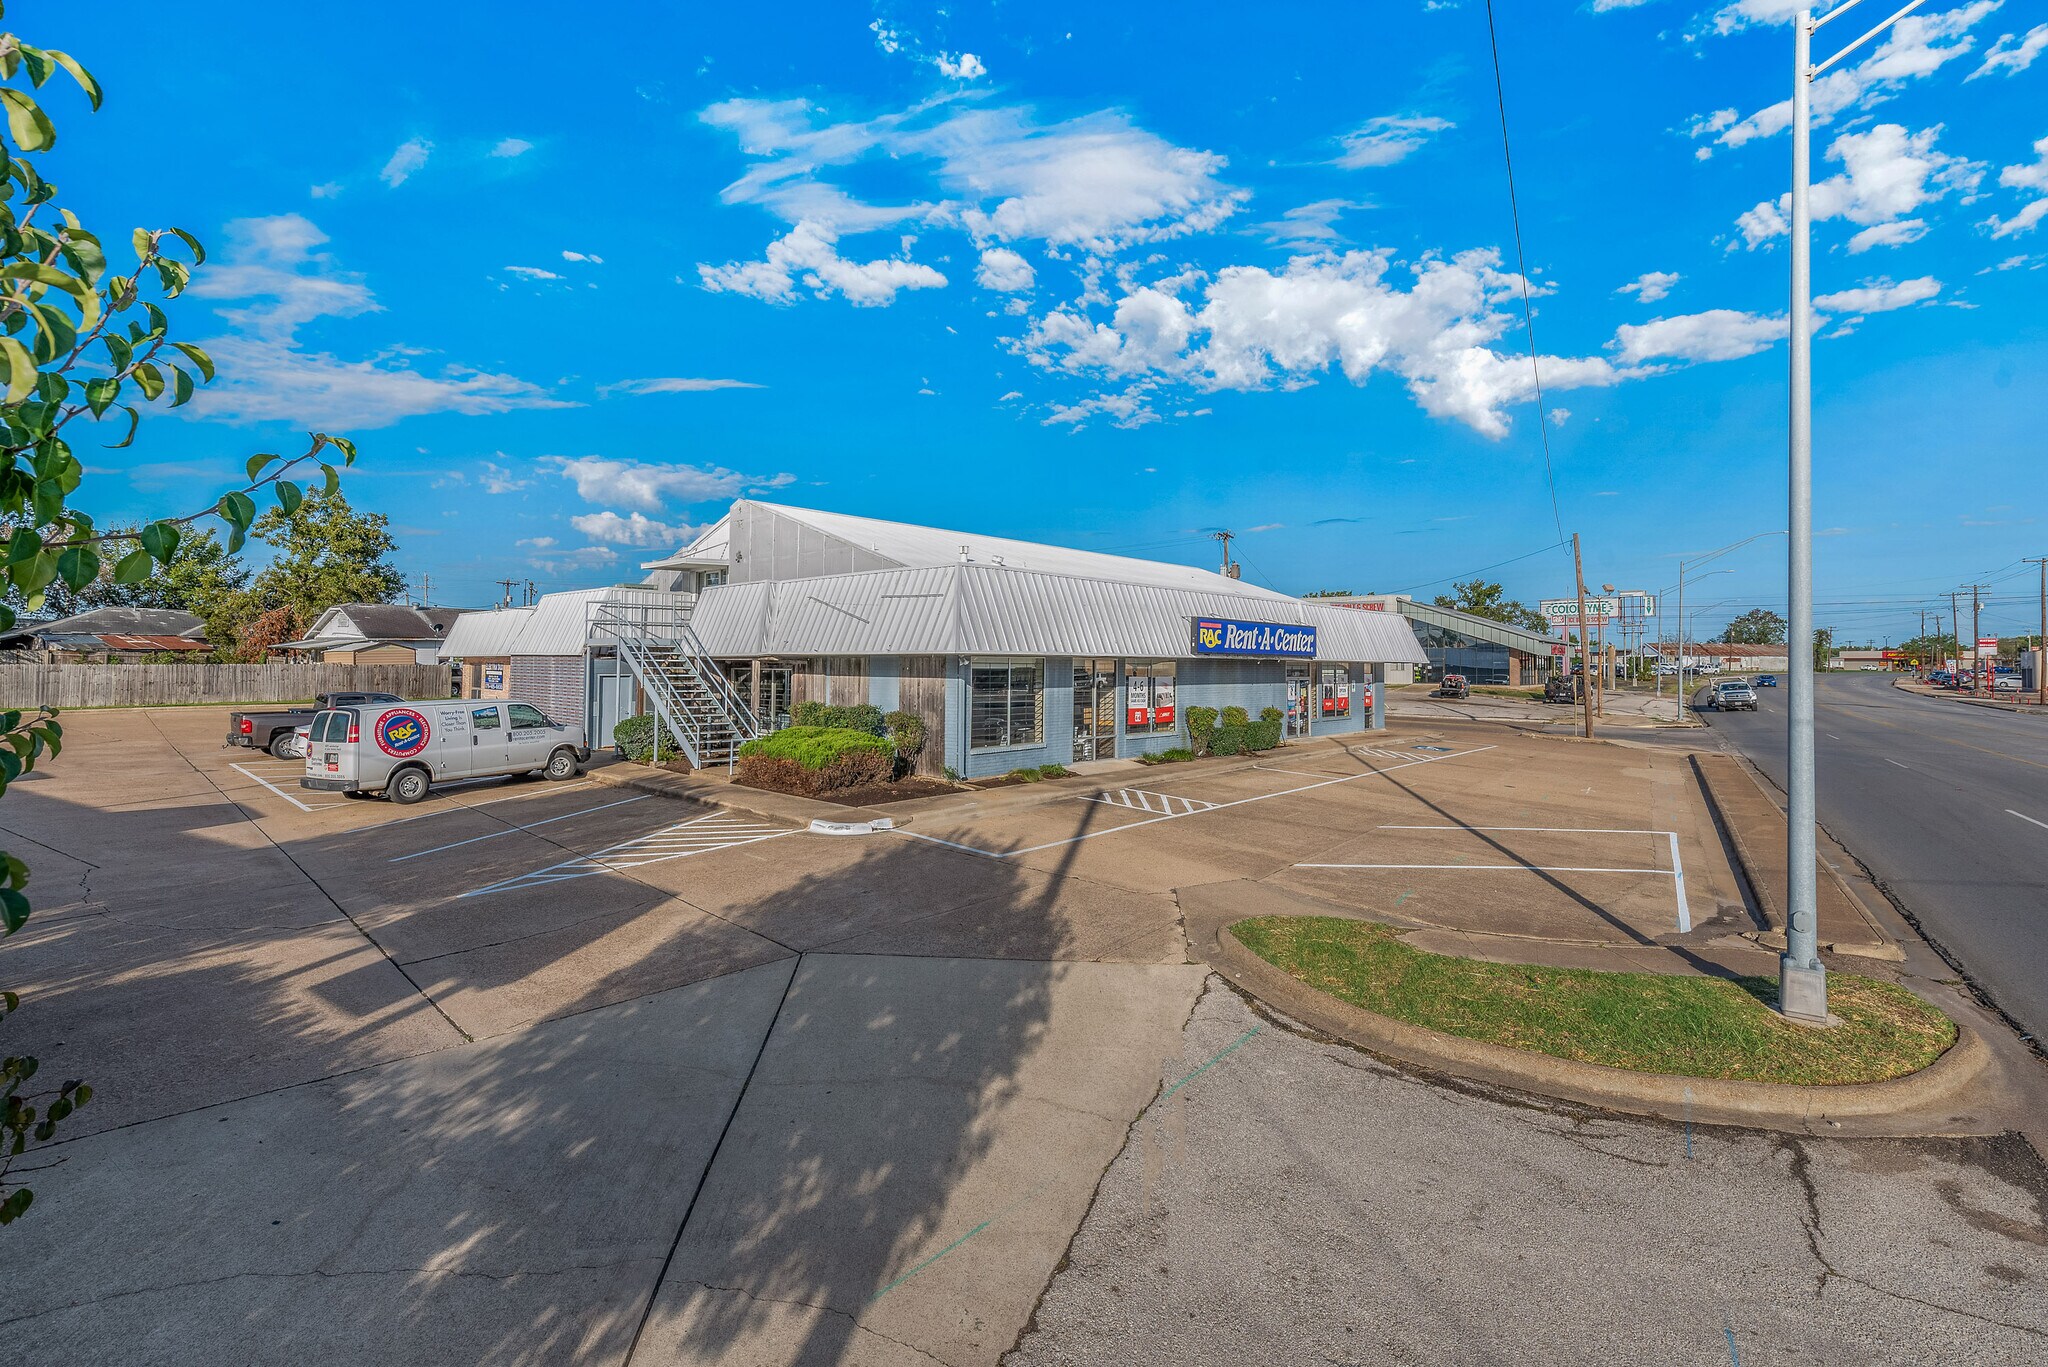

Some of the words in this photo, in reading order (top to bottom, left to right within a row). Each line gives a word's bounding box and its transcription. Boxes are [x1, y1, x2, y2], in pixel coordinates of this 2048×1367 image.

[1362, 603, 1384, 611] SCREW
[1200, 628, 1221, 648] RAC
[386, 709, 415, 719] APPLIANCES
[376, 721, 386, 747] FURNITURE
[388, 723, 416, 741] RAC
[418, 717, 429, 747] ELECTRONICS
[387, 748, 418, 756] COMPUTERS
